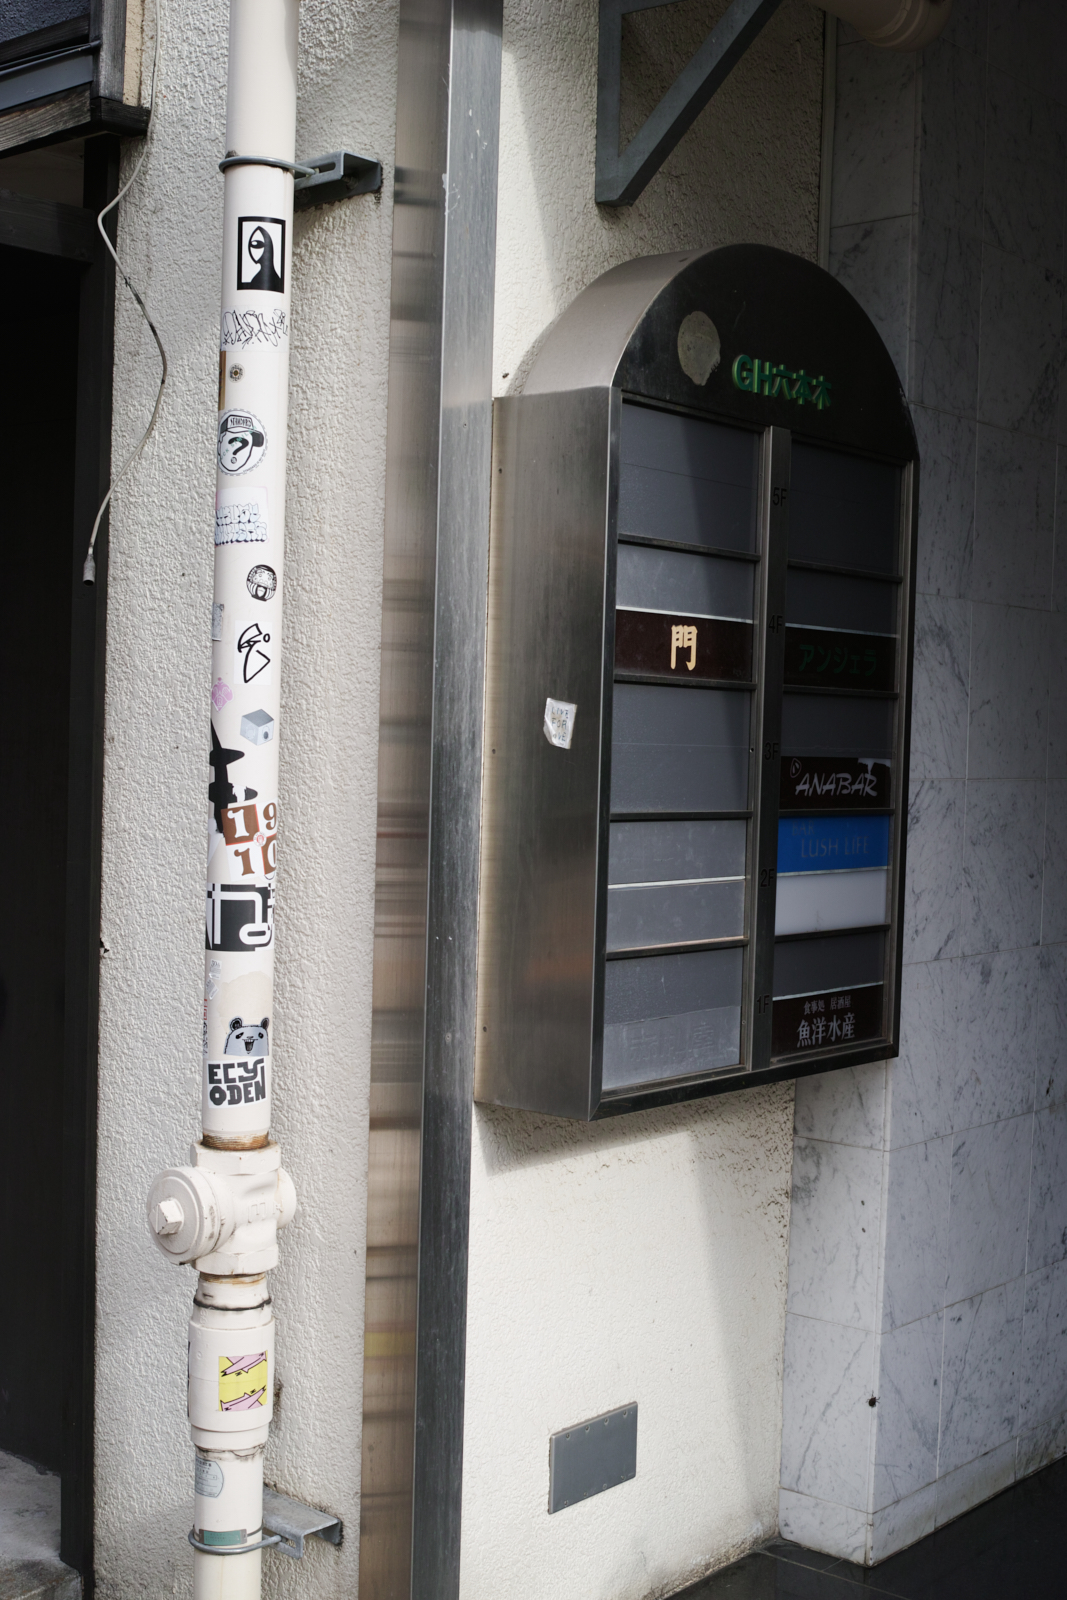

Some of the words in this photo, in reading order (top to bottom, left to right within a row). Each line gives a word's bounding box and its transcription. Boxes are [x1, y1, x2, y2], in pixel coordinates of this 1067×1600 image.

[732, 354, 832, 410] GH六本木
[772, 486, 788, 507] 5F
[768, 614, 783, 634] 4F
[670, 624, 698, 671] 門
[551, 718, 567, 730] FOR
[764, 742, 779, 761] 3F
[795, 772, 878, 797] ANABAR
[791, 820, 815, 836] BAR
[801, 838, 839, 858] LUSH
[844, 836, 870, 855] LIFE
[760, 868, 775, 888] 2F
[756, 994, 770, 1014] 1F
[803, 999, 825, 1016] 食事処
[829, 995, 852, 1011] 居酒屋
[796, 1012, 856, 1048] 魚洋水産
[209, 1065, 266, 1106] ODEN
